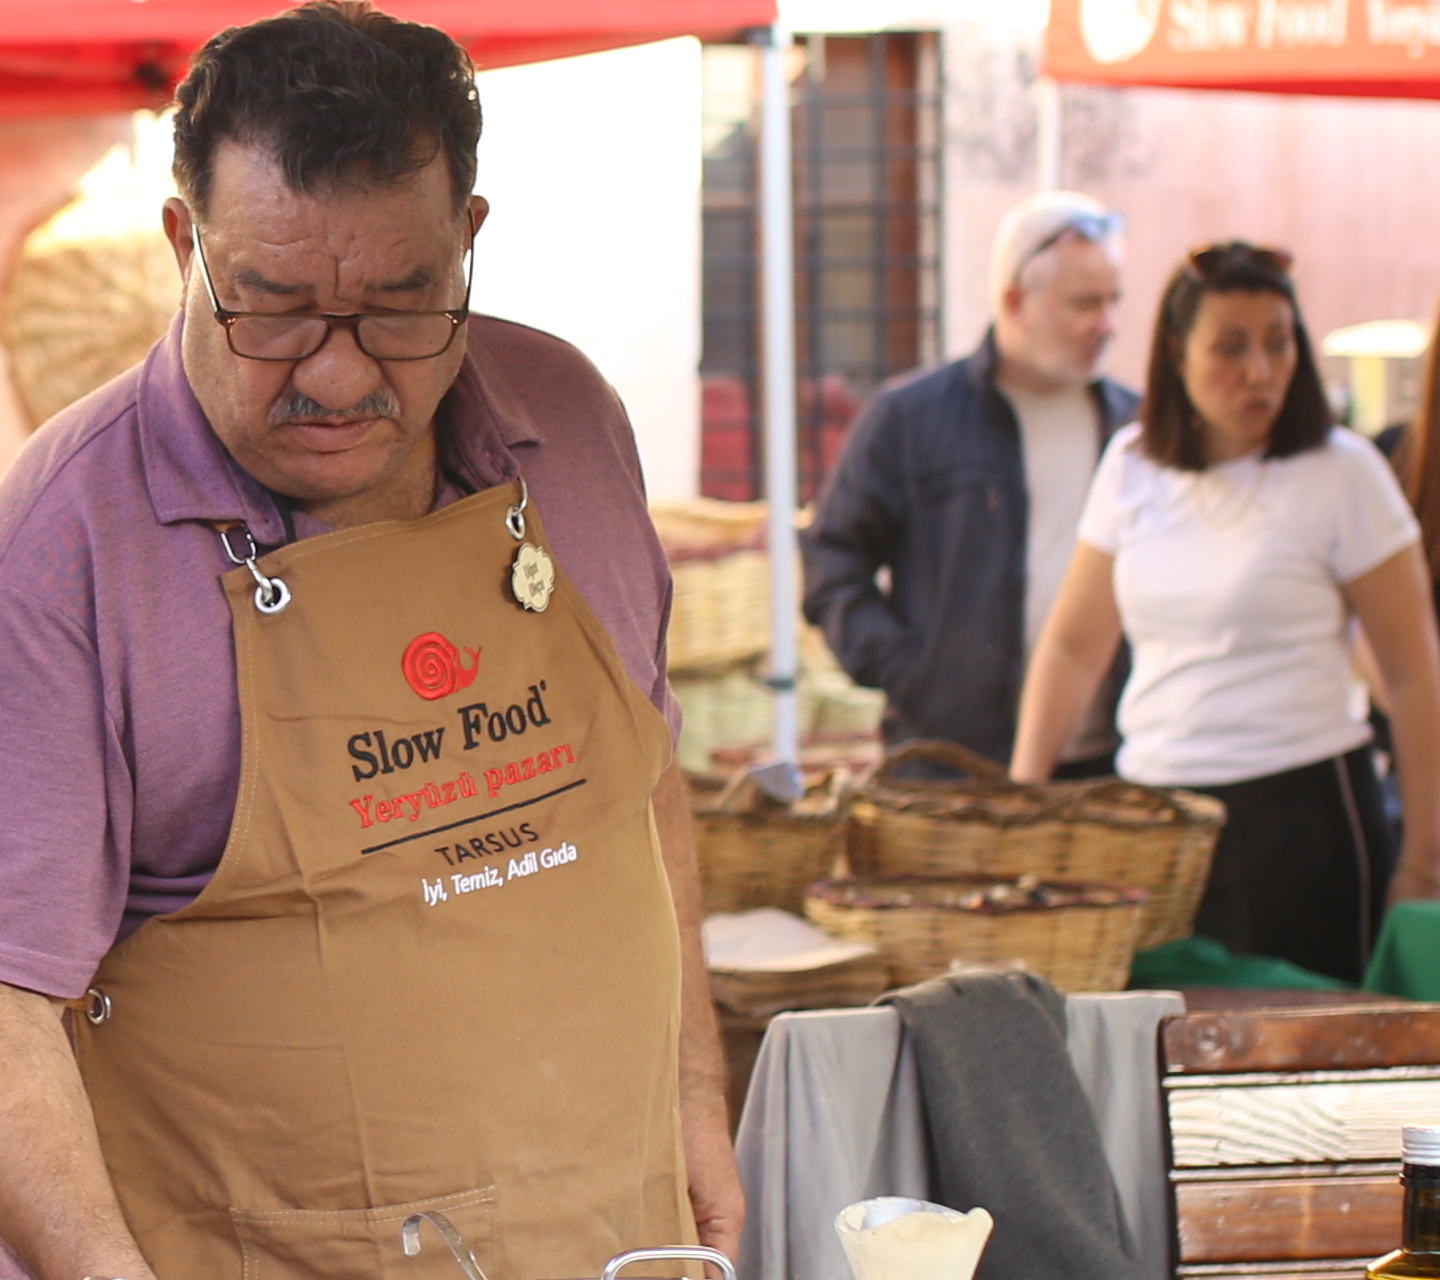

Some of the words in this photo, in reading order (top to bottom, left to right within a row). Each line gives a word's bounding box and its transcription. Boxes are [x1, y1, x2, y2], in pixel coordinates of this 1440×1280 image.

[347, 727, 445, 783] Slow
[349, 771, 478, 828] Yeryüzü
[484, 744, 576, 798] pazarı
[434, 823, 538, 866] TARSUS
[451, 866, 504, 895] Temiz,
[507, 851, 538, 881] Adil
[540, 842, 578, 869] Gıda
